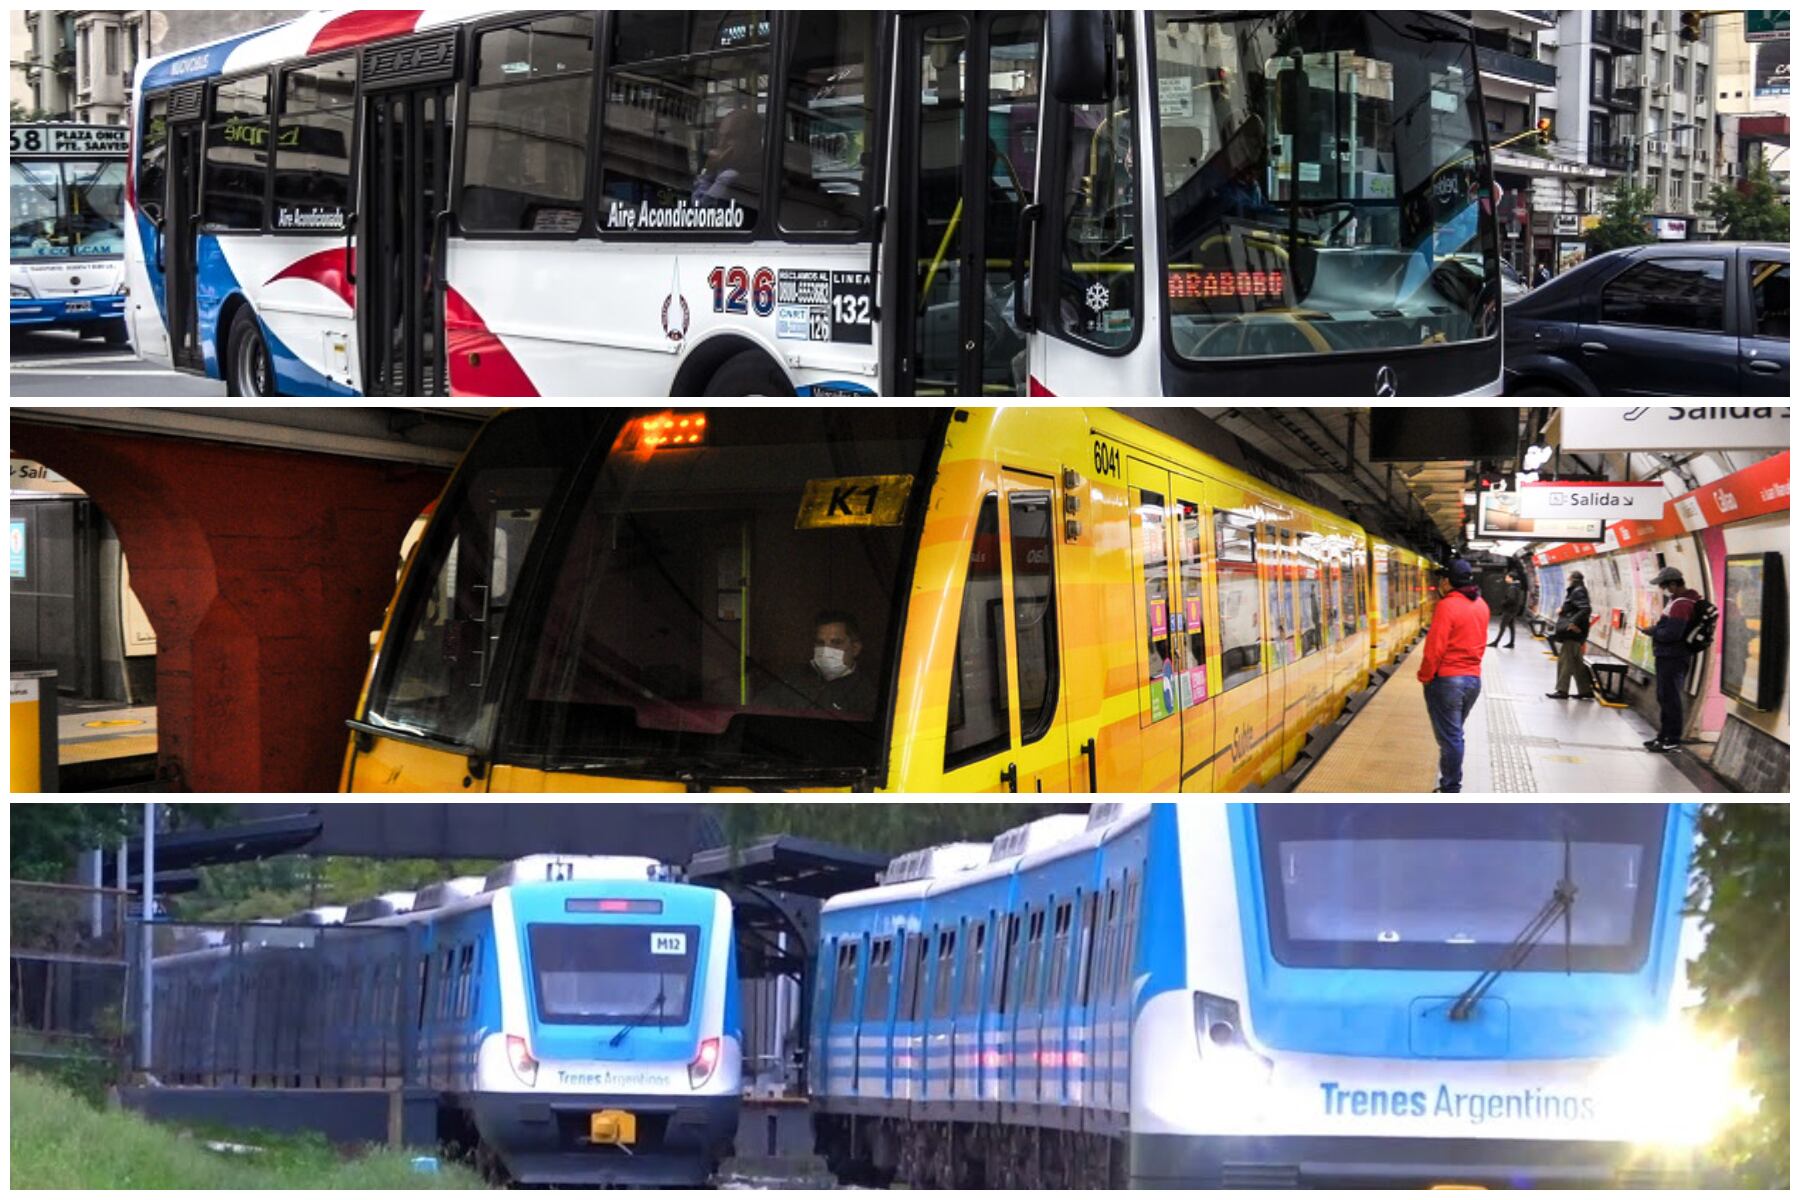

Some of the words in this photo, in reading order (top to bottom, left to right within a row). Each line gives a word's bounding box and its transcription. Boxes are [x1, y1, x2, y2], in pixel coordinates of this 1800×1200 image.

[55, 130, 92, 140] PLAZA
[96, 131, 126, 140] ONCE
[55, 142, 82, 151] PTE.
[278, 207, 293, 227] Aire
[294, 206, 343, 227] Acondicionado
[607, 200, 636, 227] Aire
[637, 198, 744, 228] Acondicionado
[833, 273, 871, 284] LINEA
[707, 266, 776, 317] 126
[833, 294, 870, 325] 132
[1094, 440, 1121, 480] 6041
[827, 484, 880, 517] K1
[1570, 492, 1620, 506] Salida
[656, 937, 681, 950] M12
[558, 1070, 602, 1085] Trenes
[604, 1071, 670, 1088] Argentinos
[1320, 1081, 1426, 1117] Trenes
[1432, 1083, 1596, 1125] Argentinos
